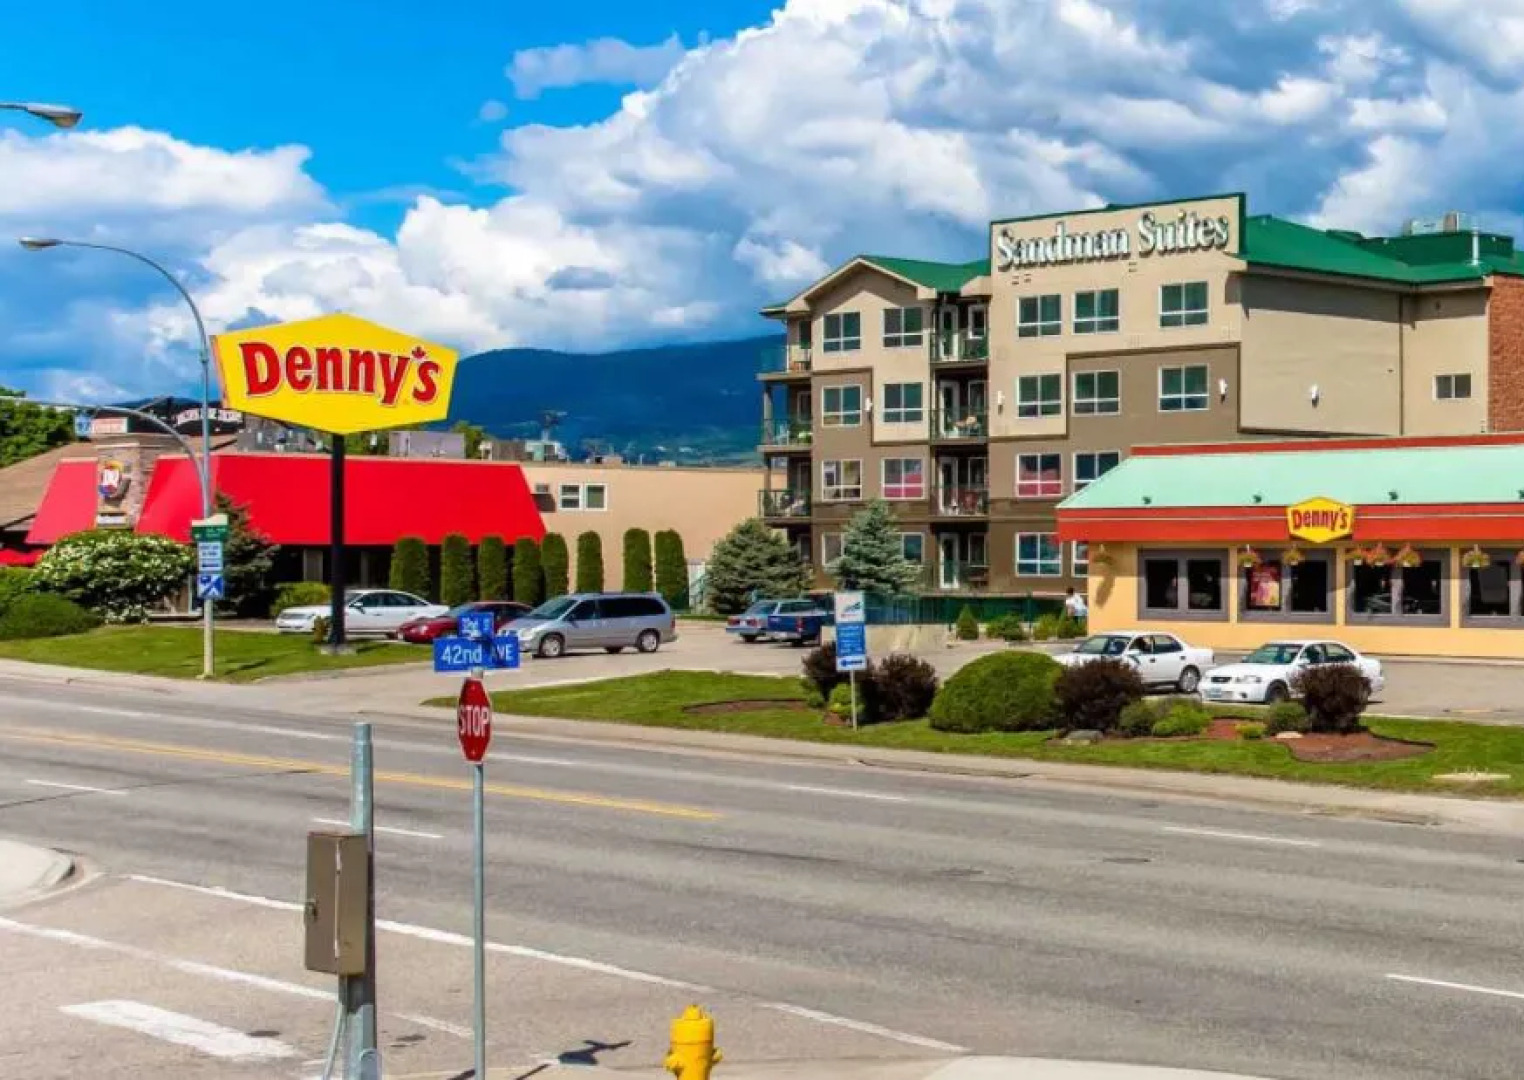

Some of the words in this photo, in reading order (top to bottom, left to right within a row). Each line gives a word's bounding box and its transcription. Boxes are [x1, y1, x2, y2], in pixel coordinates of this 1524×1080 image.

[998, 221, 1131, 271] Sandman
[1137, 209, 1229, 258] Suites
[239, 342, 441, 406] Denny's
[1292, 507, 1348, 532] Denny's
[440, 643, 482, 665] 42nd
[459, 704, 490, 738] STOP
